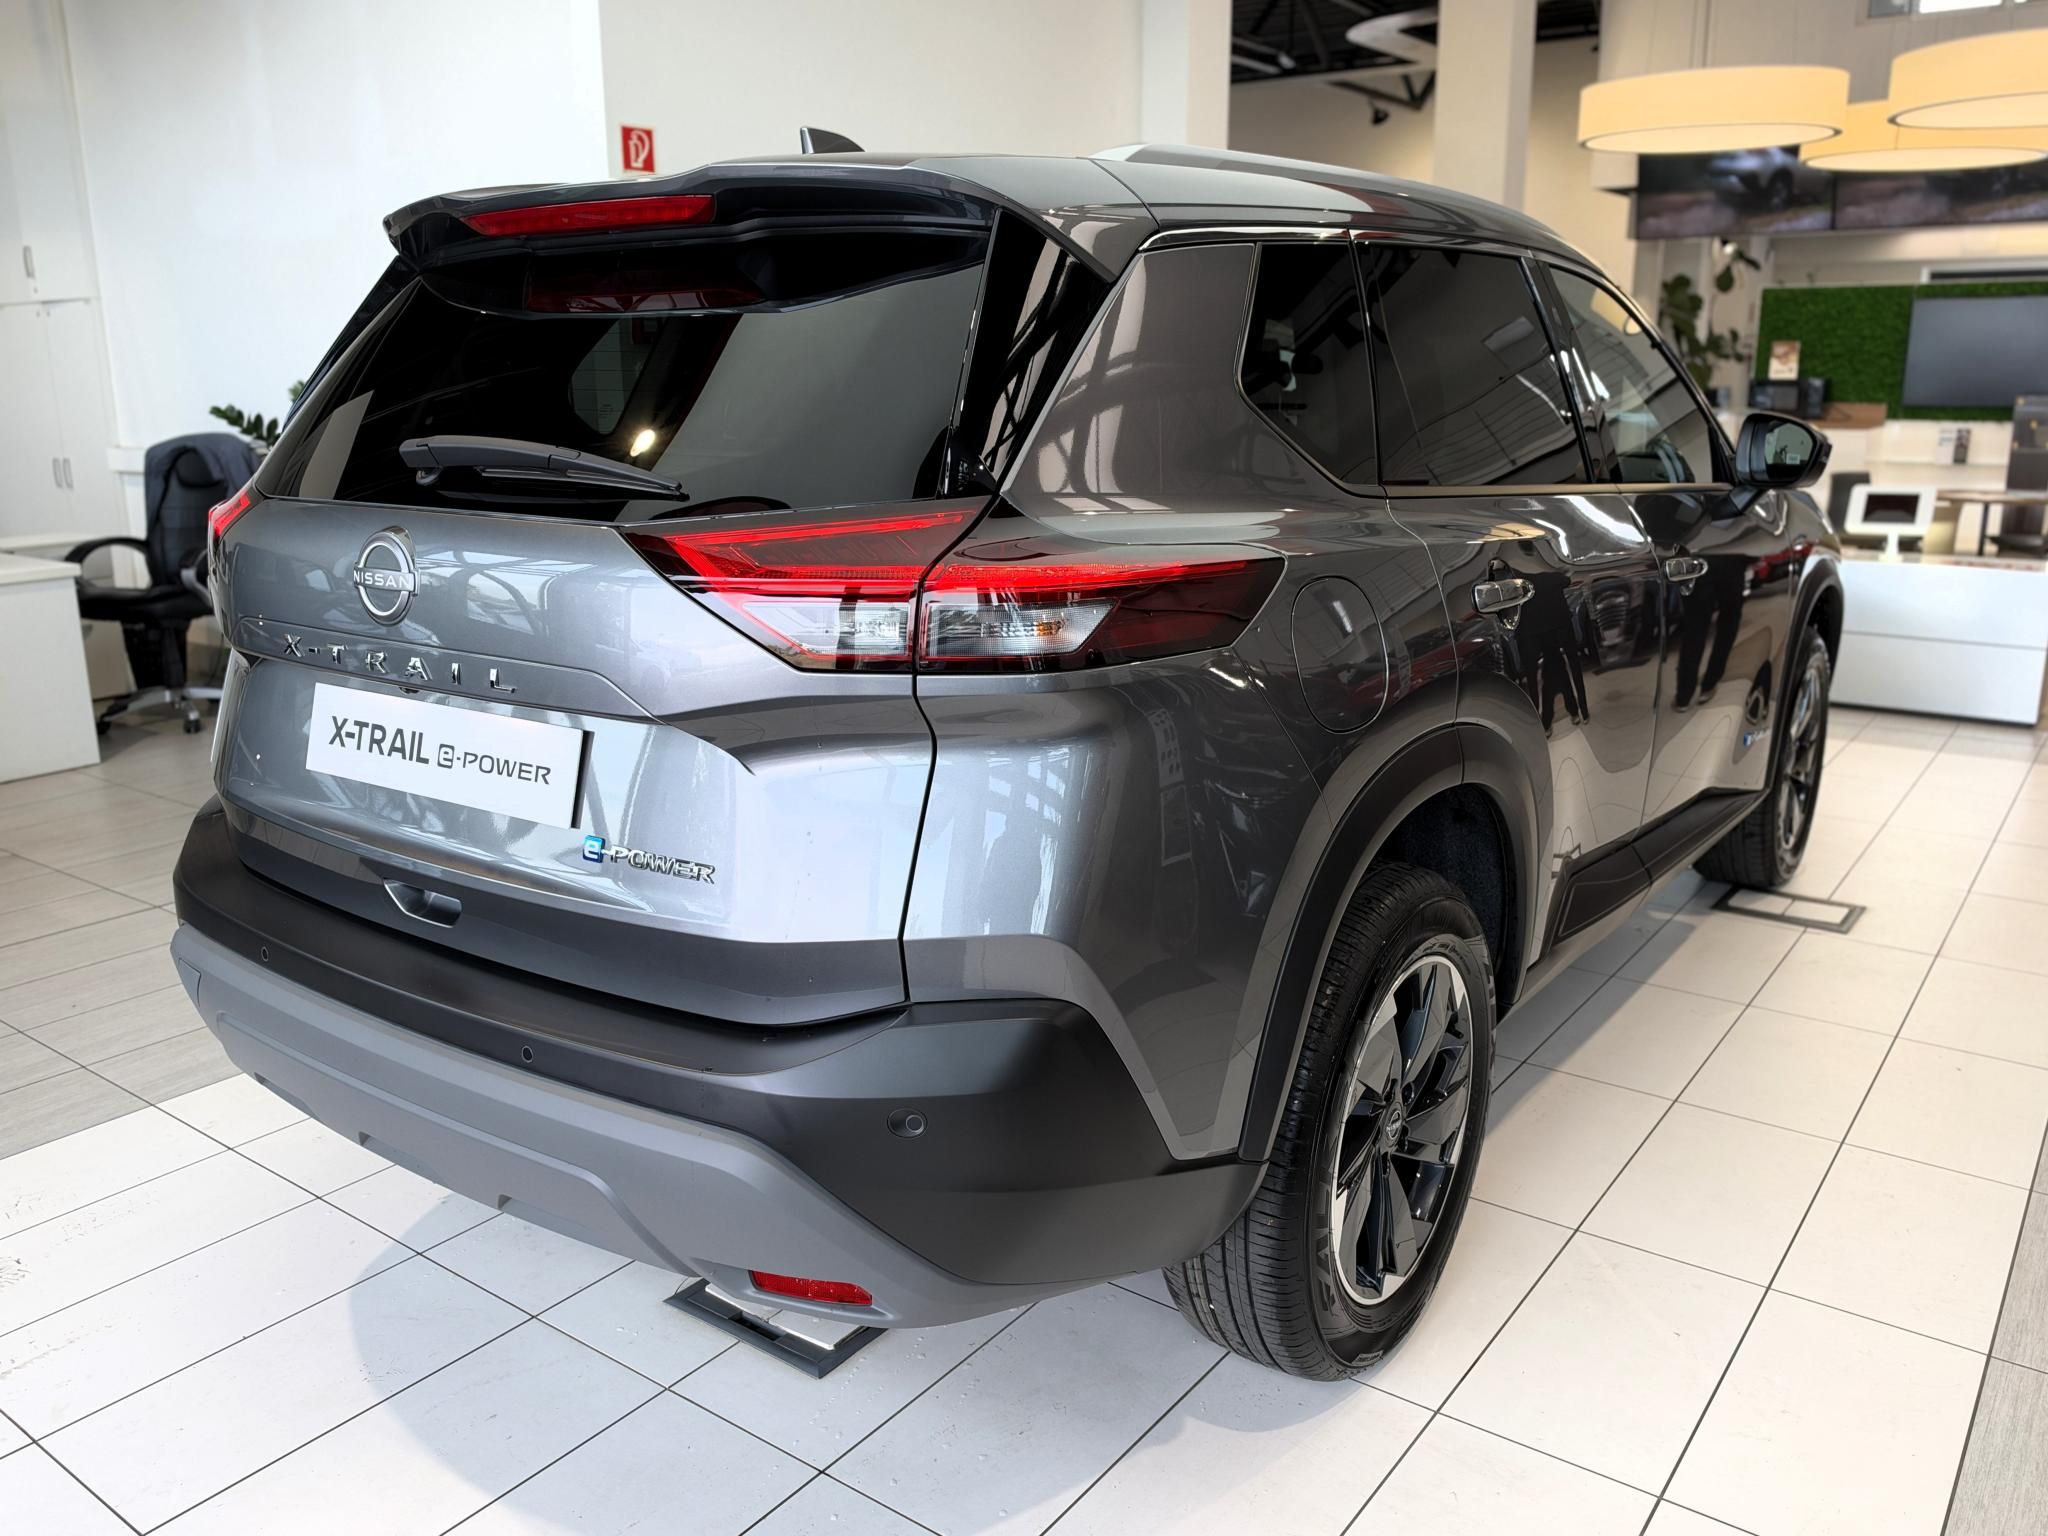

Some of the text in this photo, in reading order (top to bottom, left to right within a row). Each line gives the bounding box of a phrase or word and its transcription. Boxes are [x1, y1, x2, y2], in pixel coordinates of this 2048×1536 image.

[353, 569, 411, 589] NISSAN
[283, 633, 519, 694] X-TRAIL
[328, 715, 552, 785] X-TRAIL e-POWER
[582, 835, 716, 884] e-POWER
